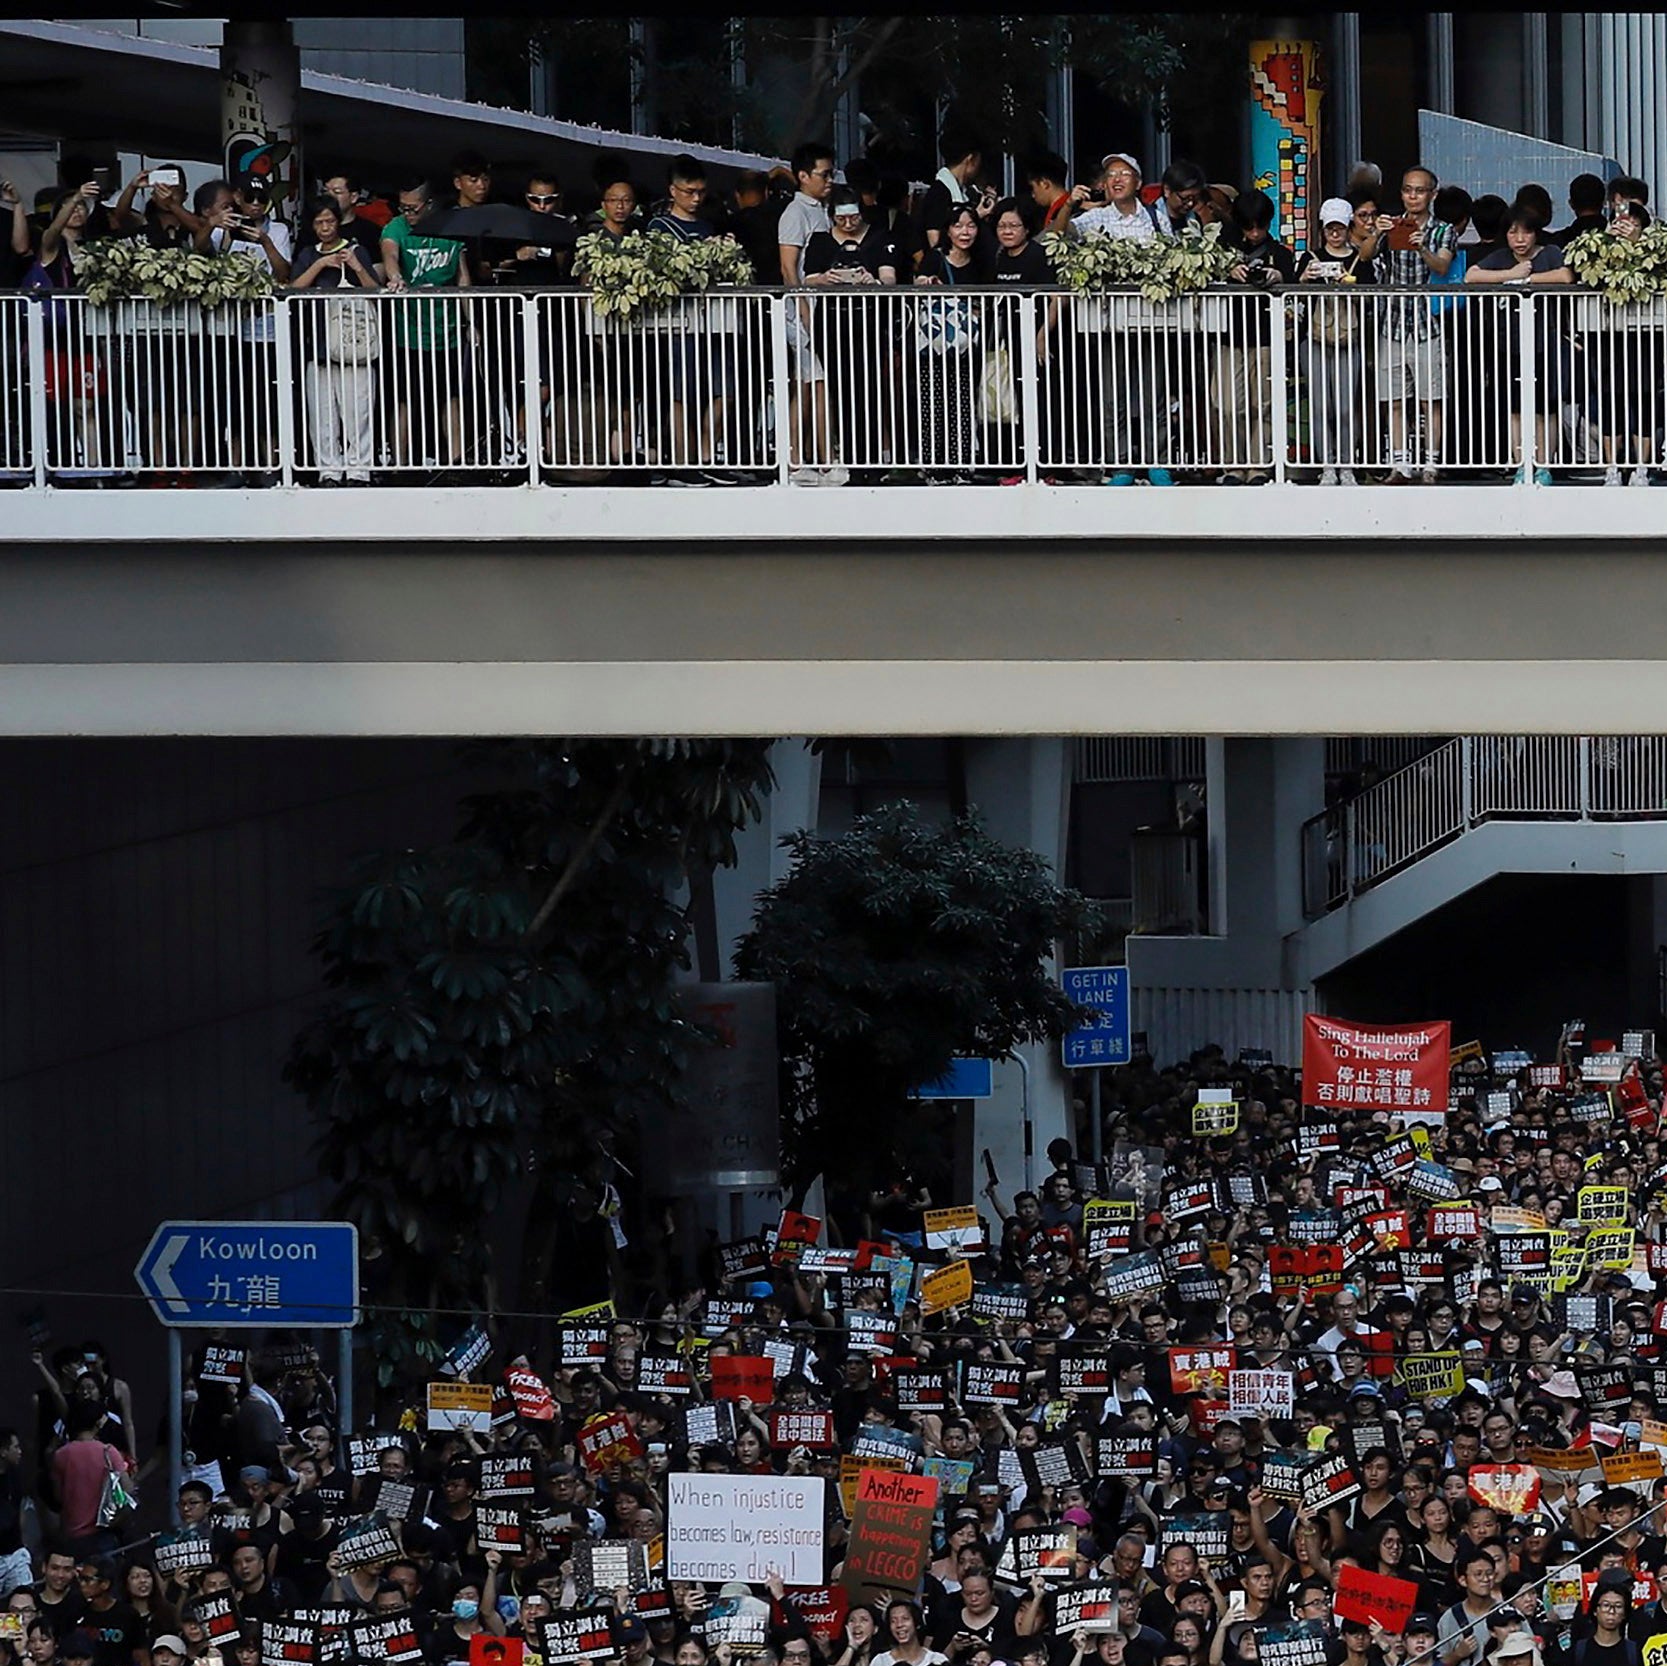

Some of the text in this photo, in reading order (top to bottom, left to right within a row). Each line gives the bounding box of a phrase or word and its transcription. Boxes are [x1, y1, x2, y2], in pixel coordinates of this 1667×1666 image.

[1072, 973, 1118, 988] GET IN
[1078, 990, 1114, 1004] LANE
[1318, 1026, 1430, 1047] Sing Hallelujah
[1332, 1044, 1419, 1061] To The Lord
[1337, 1067, 1413, 1086] 停止濫權
[1318, 1083, 1431, 1105] 否則獻唱聖詩
[201, 1238, 316, 1261] Kowloon
[208, 1276, 281, 1308] 九龍
[1405, 1357, 1461, 1377] STAND UP
[1409, 1378, 1430, 1392] FOR
[671, 1484, 805, 1513] When injustice
[864, 1475, 924, 1505] Another
[866, 1504, 923, 1531] CRIME is
[669, 1520, 726, 1544] becomes
[860, 1524, 921, 1558] happening
[670, 1551, 737, 1578] becomes
[865, 1549, 918, 1582] LEGCO
[788, 1590, 830, 1606] FREE
